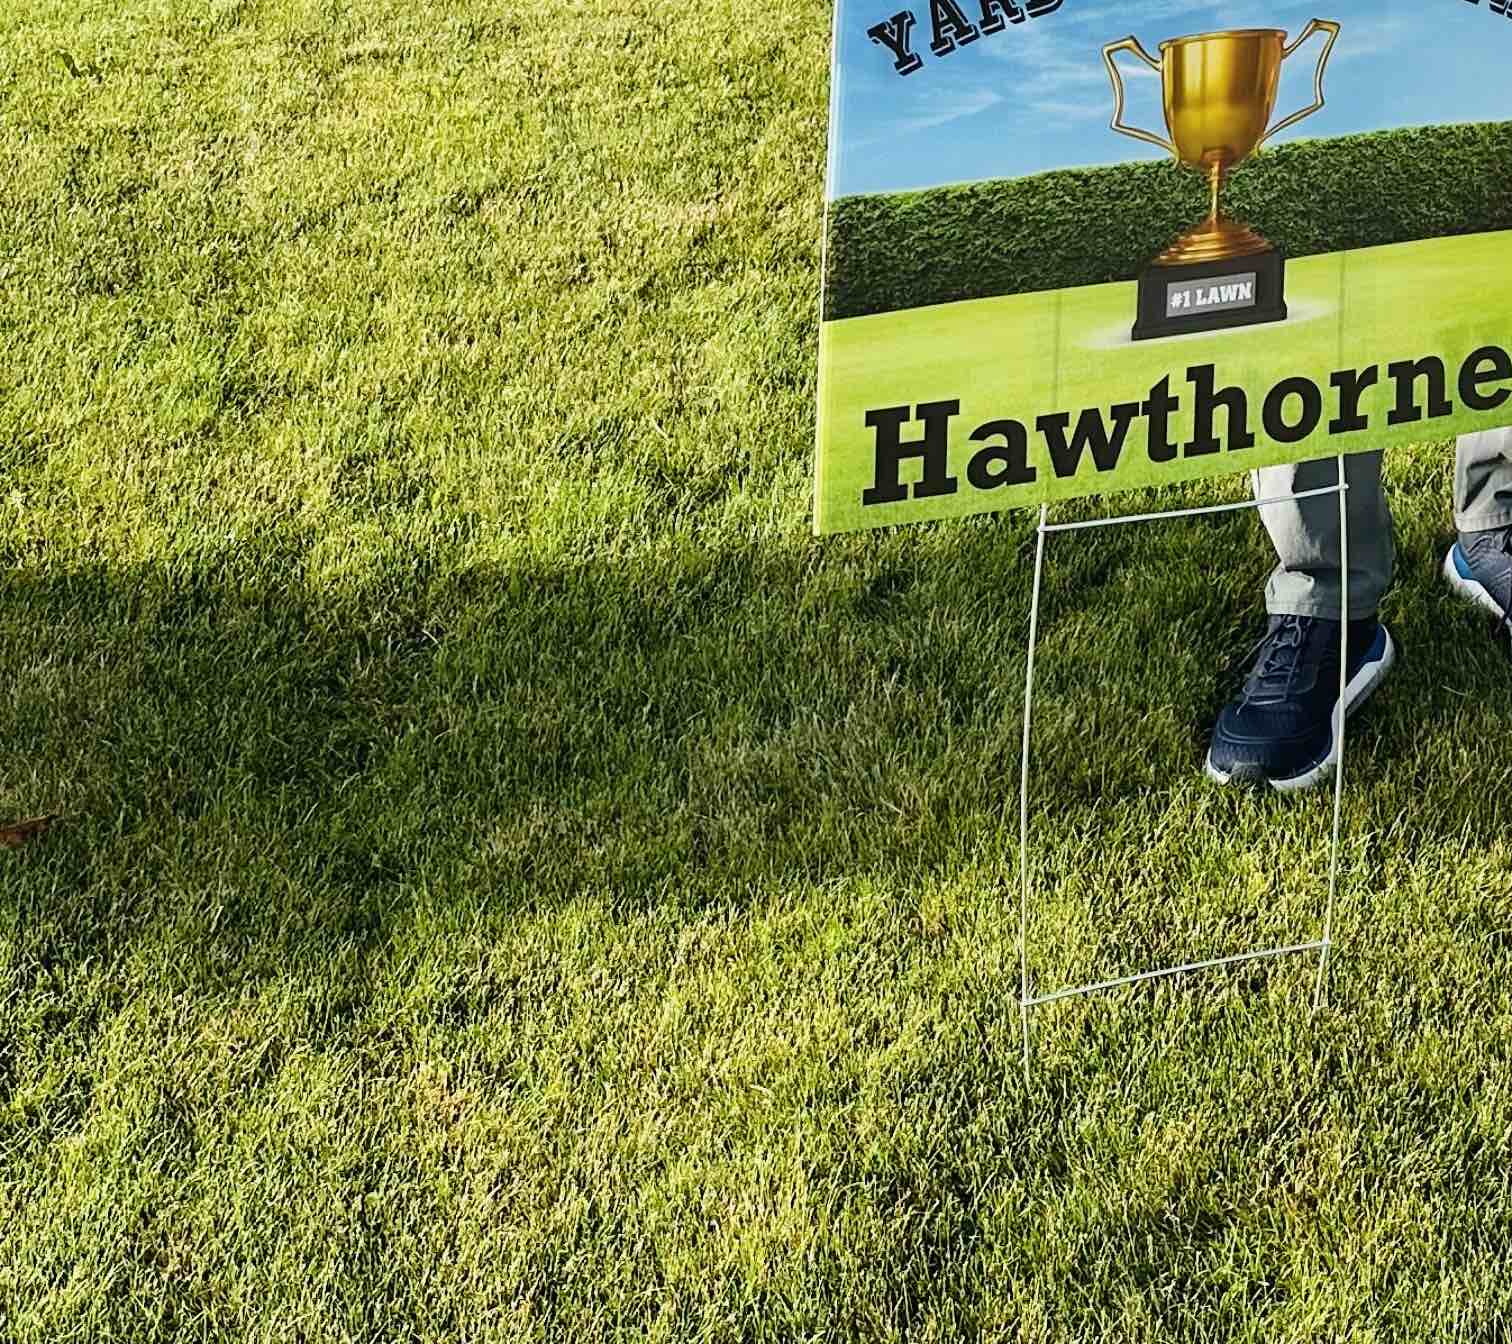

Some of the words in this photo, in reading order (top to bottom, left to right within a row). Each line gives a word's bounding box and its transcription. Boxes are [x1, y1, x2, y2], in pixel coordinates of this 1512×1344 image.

[1170, 289, 1192, 309] #1
[1196, 281, 1252, 306] LAWN
[863, 346, 1512, 505] Hawthorne
